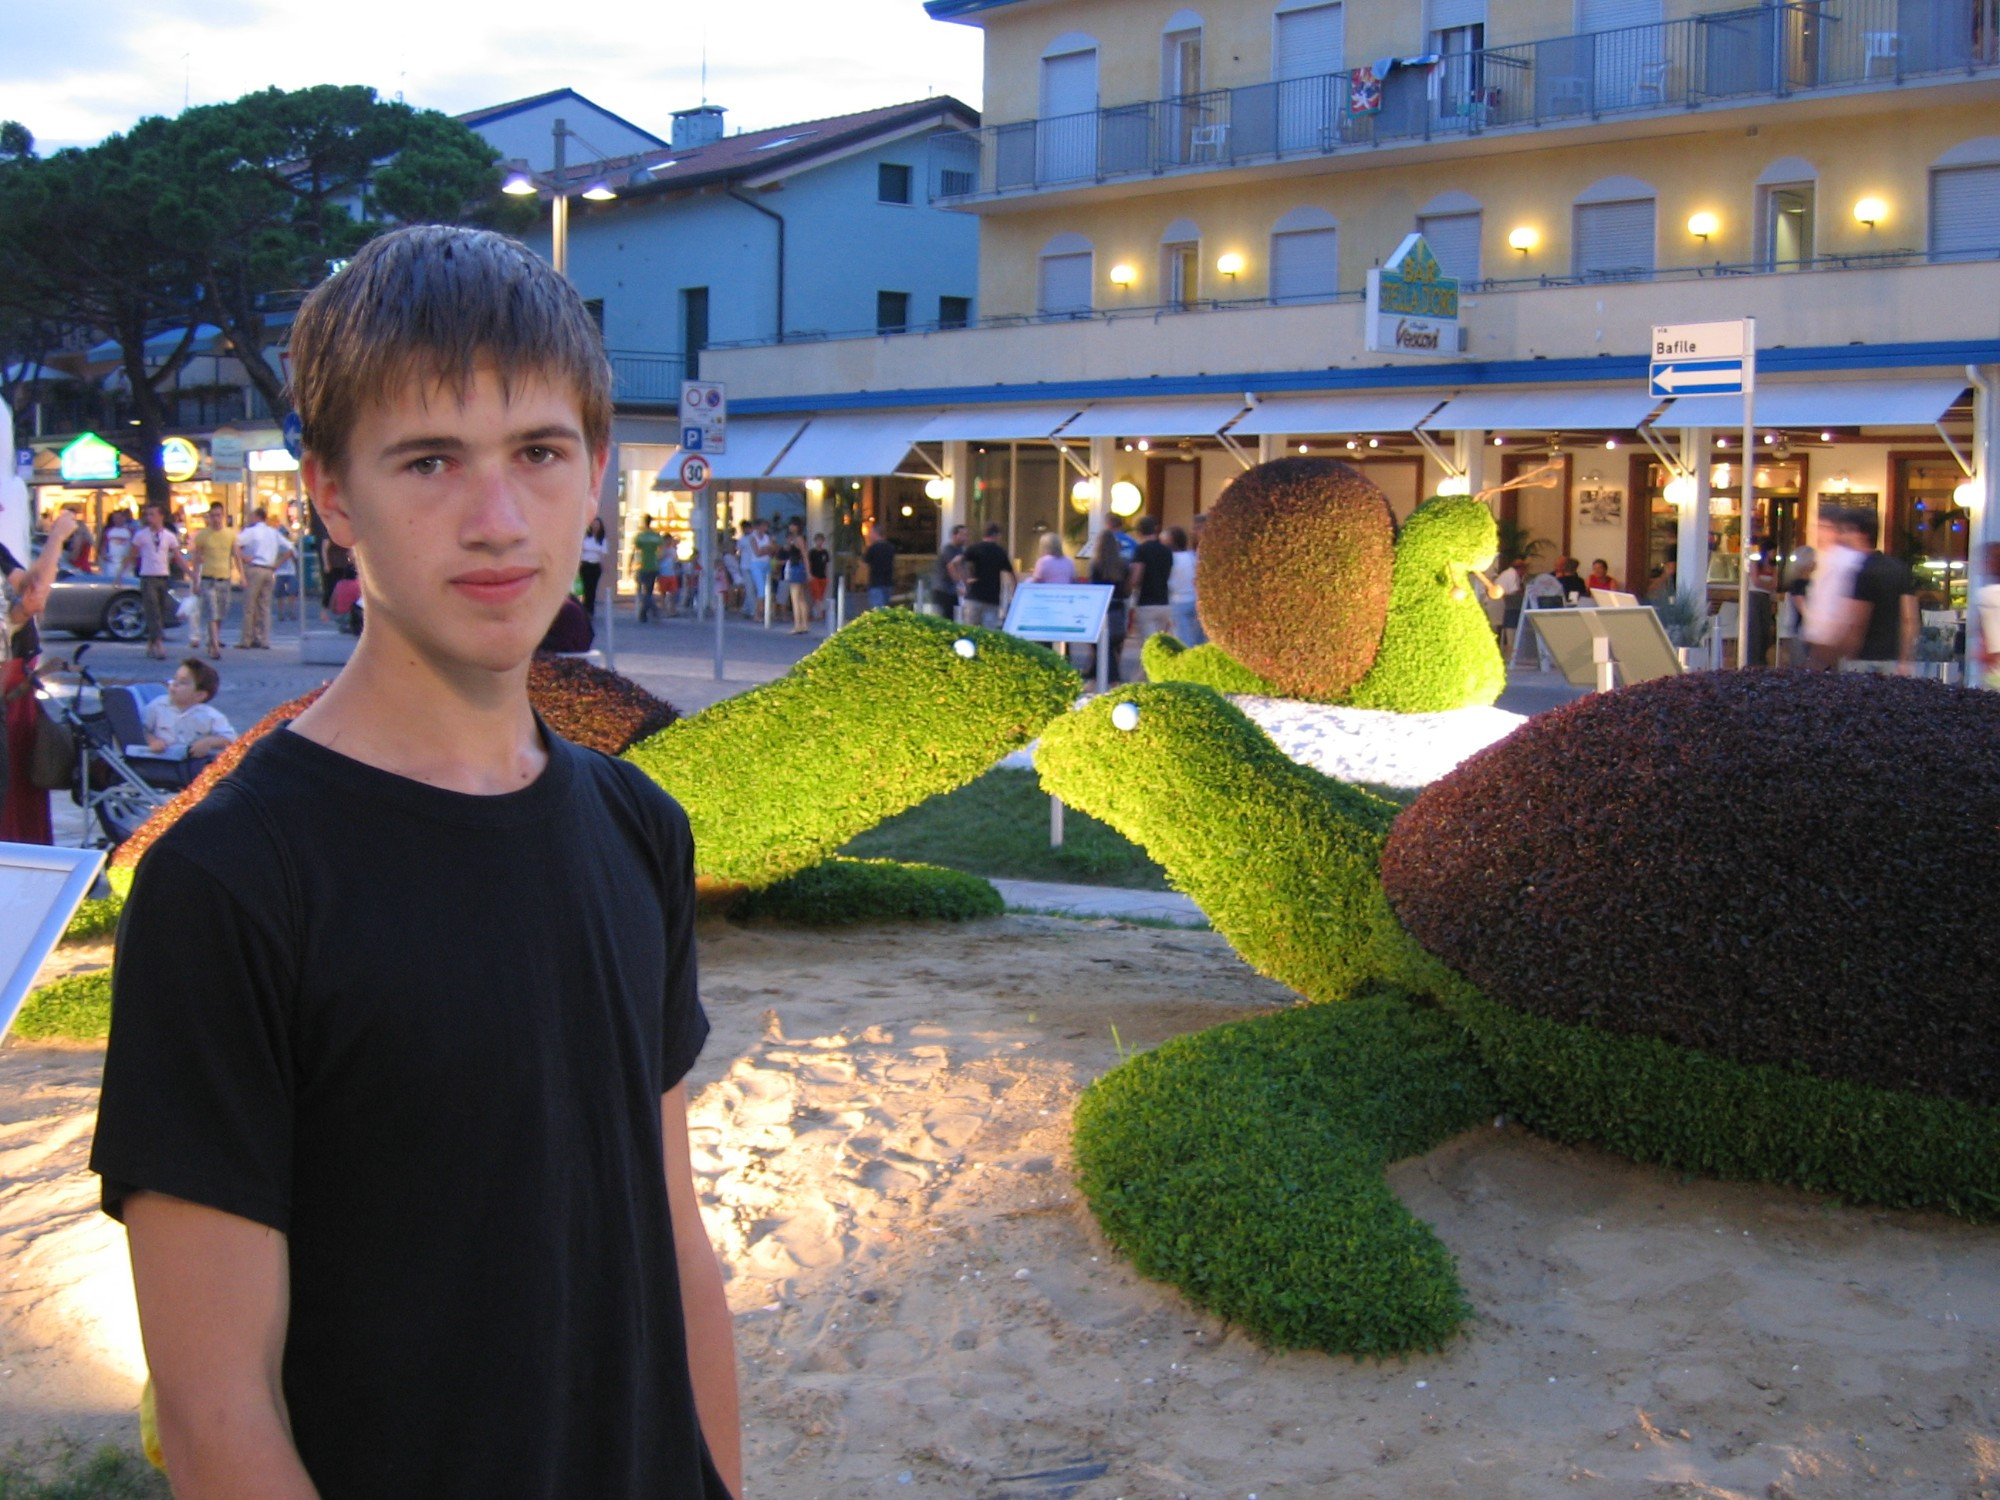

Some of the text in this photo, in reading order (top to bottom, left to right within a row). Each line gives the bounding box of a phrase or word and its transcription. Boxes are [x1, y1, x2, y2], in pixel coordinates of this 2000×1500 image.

[1403, 256, 1436, 283] BAR
[1380, 282, 1420, 313] STELLA
[1656, 340, 1696, 355] Bafile
[687, 464, 703, 481] 30
